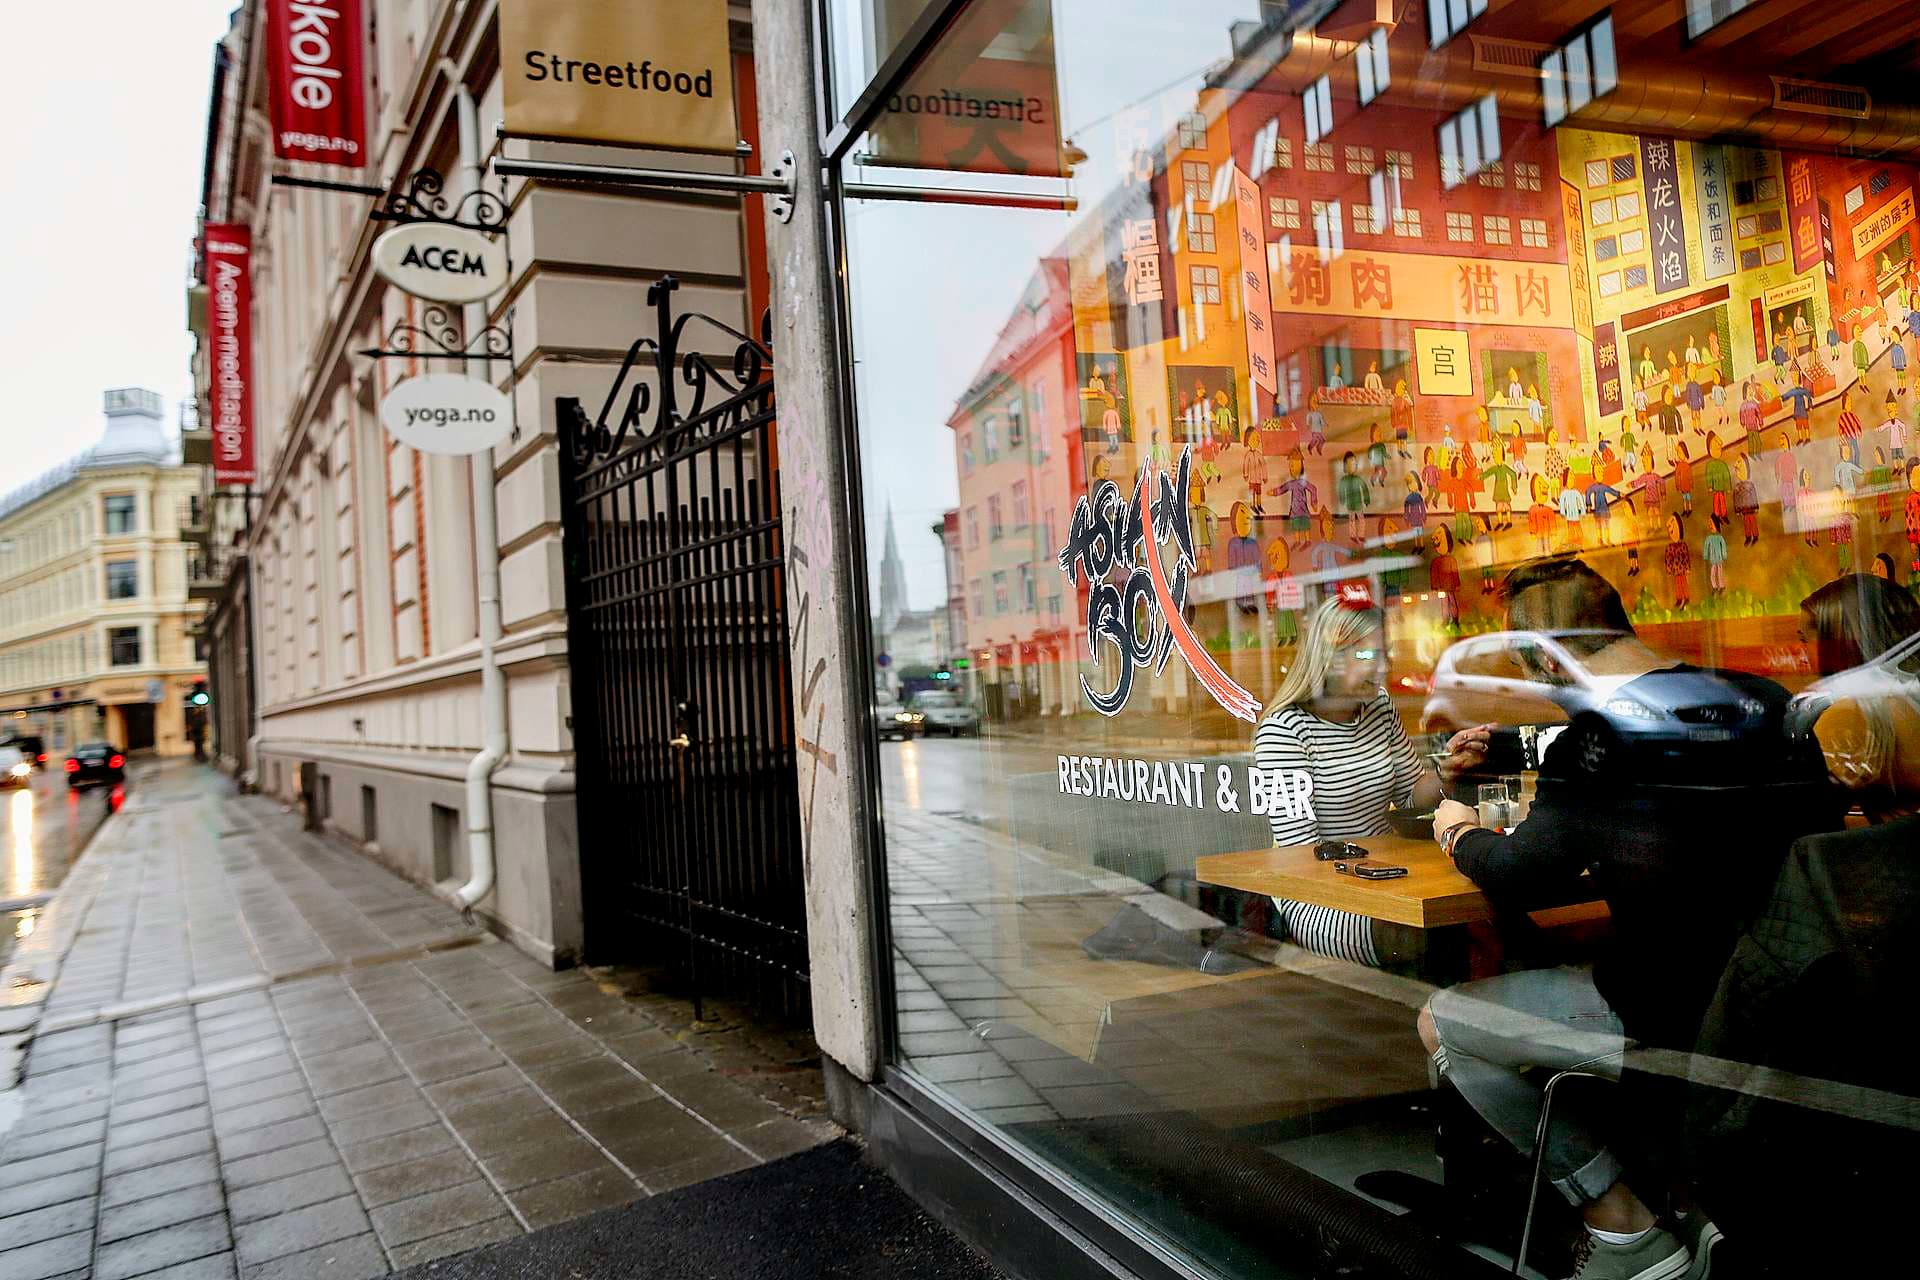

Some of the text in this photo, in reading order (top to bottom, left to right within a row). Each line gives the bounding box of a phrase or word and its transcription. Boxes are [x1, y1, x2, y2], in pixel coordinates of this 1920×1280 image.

[288, 0, 342, 109] kole
[525, 50, 713, 99] Streetfood
[280, 131, 359, 153] yoga.no
[1647, 141, 1682, 284] 辣龙火焰
[1702, 158, 1726, 264] 米饭和面条
[1858, 198, 1912, 248] 亚洲的房子
[400, 244, 487, 277] ACEM
[1290, 251, 1552, 318] 狗肉 猫肉
[404, 407, 496, 427] yoga.no
[1057, 443, 1198, 587] ASIAN
[1079, 553, 1210, 718] BOY
[1057, 754, 1317, 822] RESTAURANT & BAR
